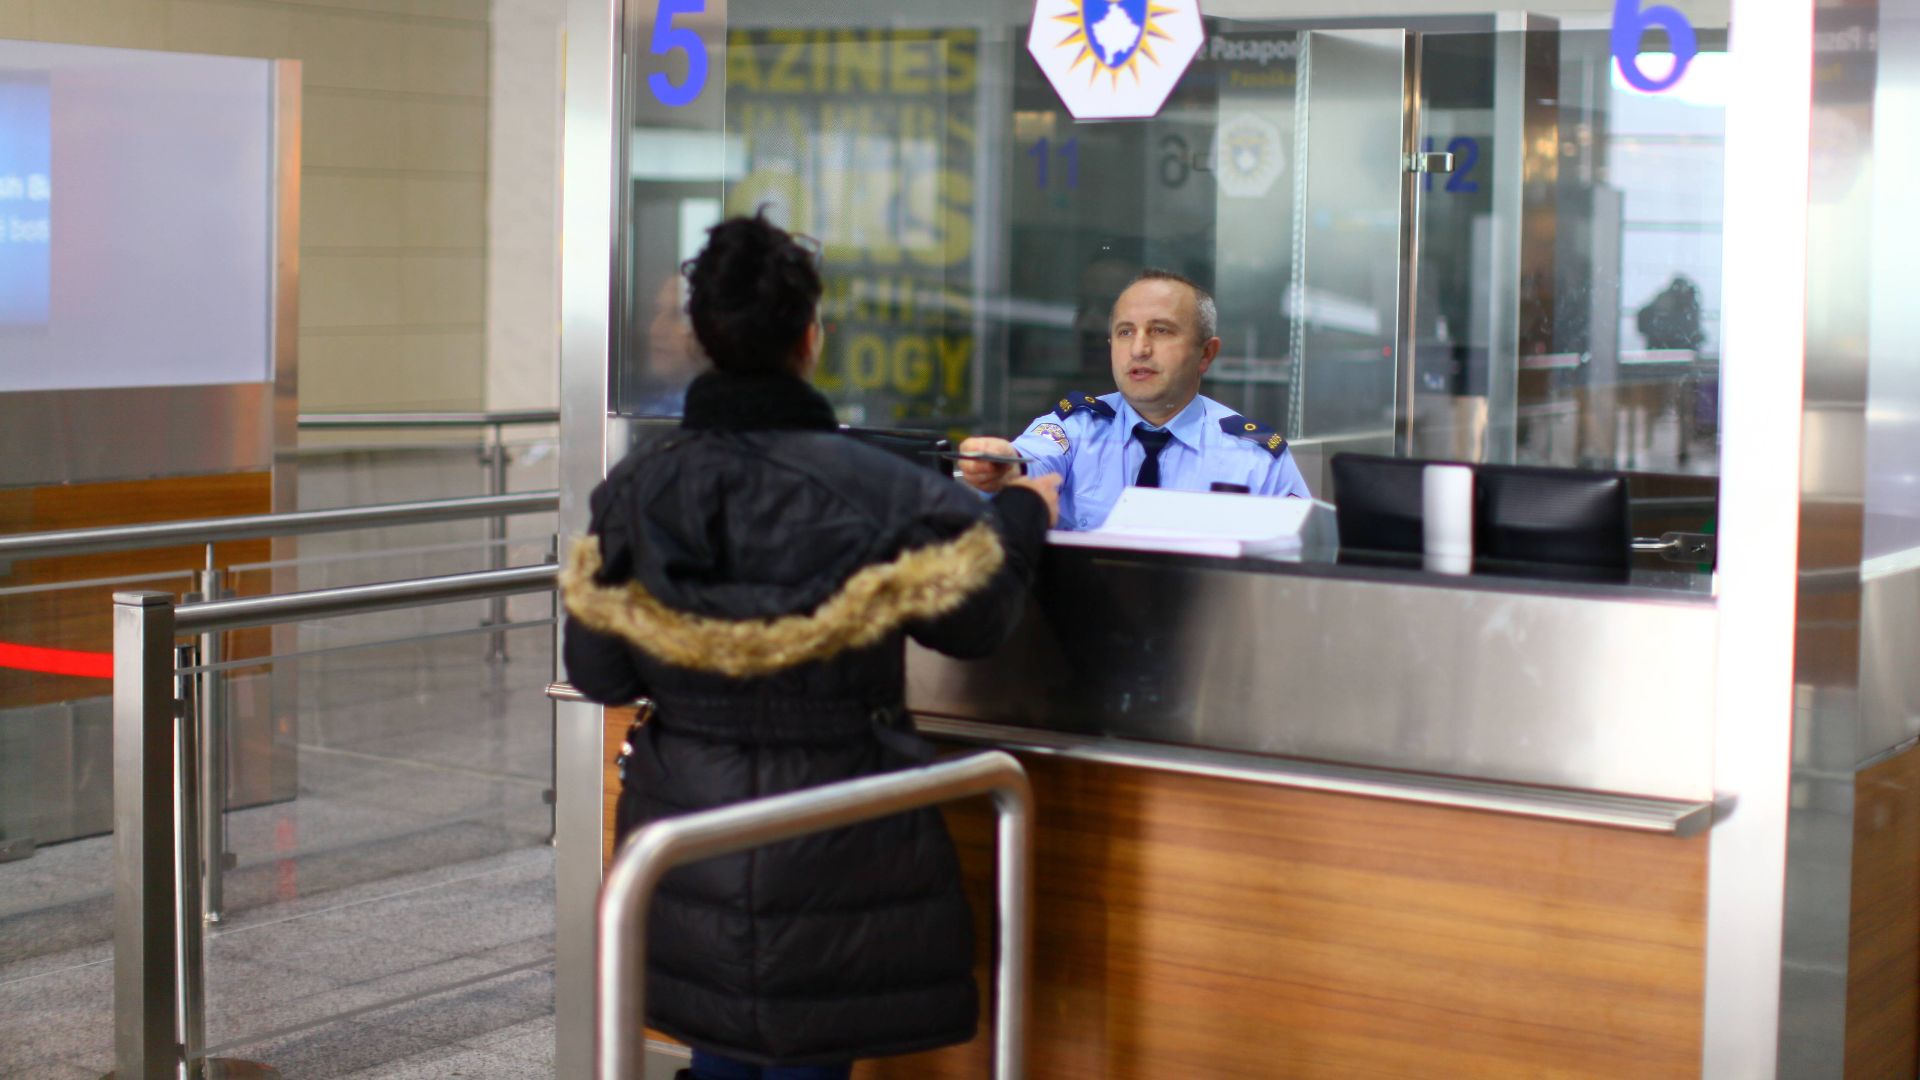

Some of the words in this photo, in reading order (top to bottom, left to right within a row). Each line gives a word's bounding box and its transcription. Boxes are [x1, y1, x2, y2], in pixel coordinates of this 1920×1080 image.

[647, 0, 709, 107] 5
[726, 27, 979, 95] AZINES
[1610, 0, 1698, 93] 6
[1028, 135, 1079, 190] 11
